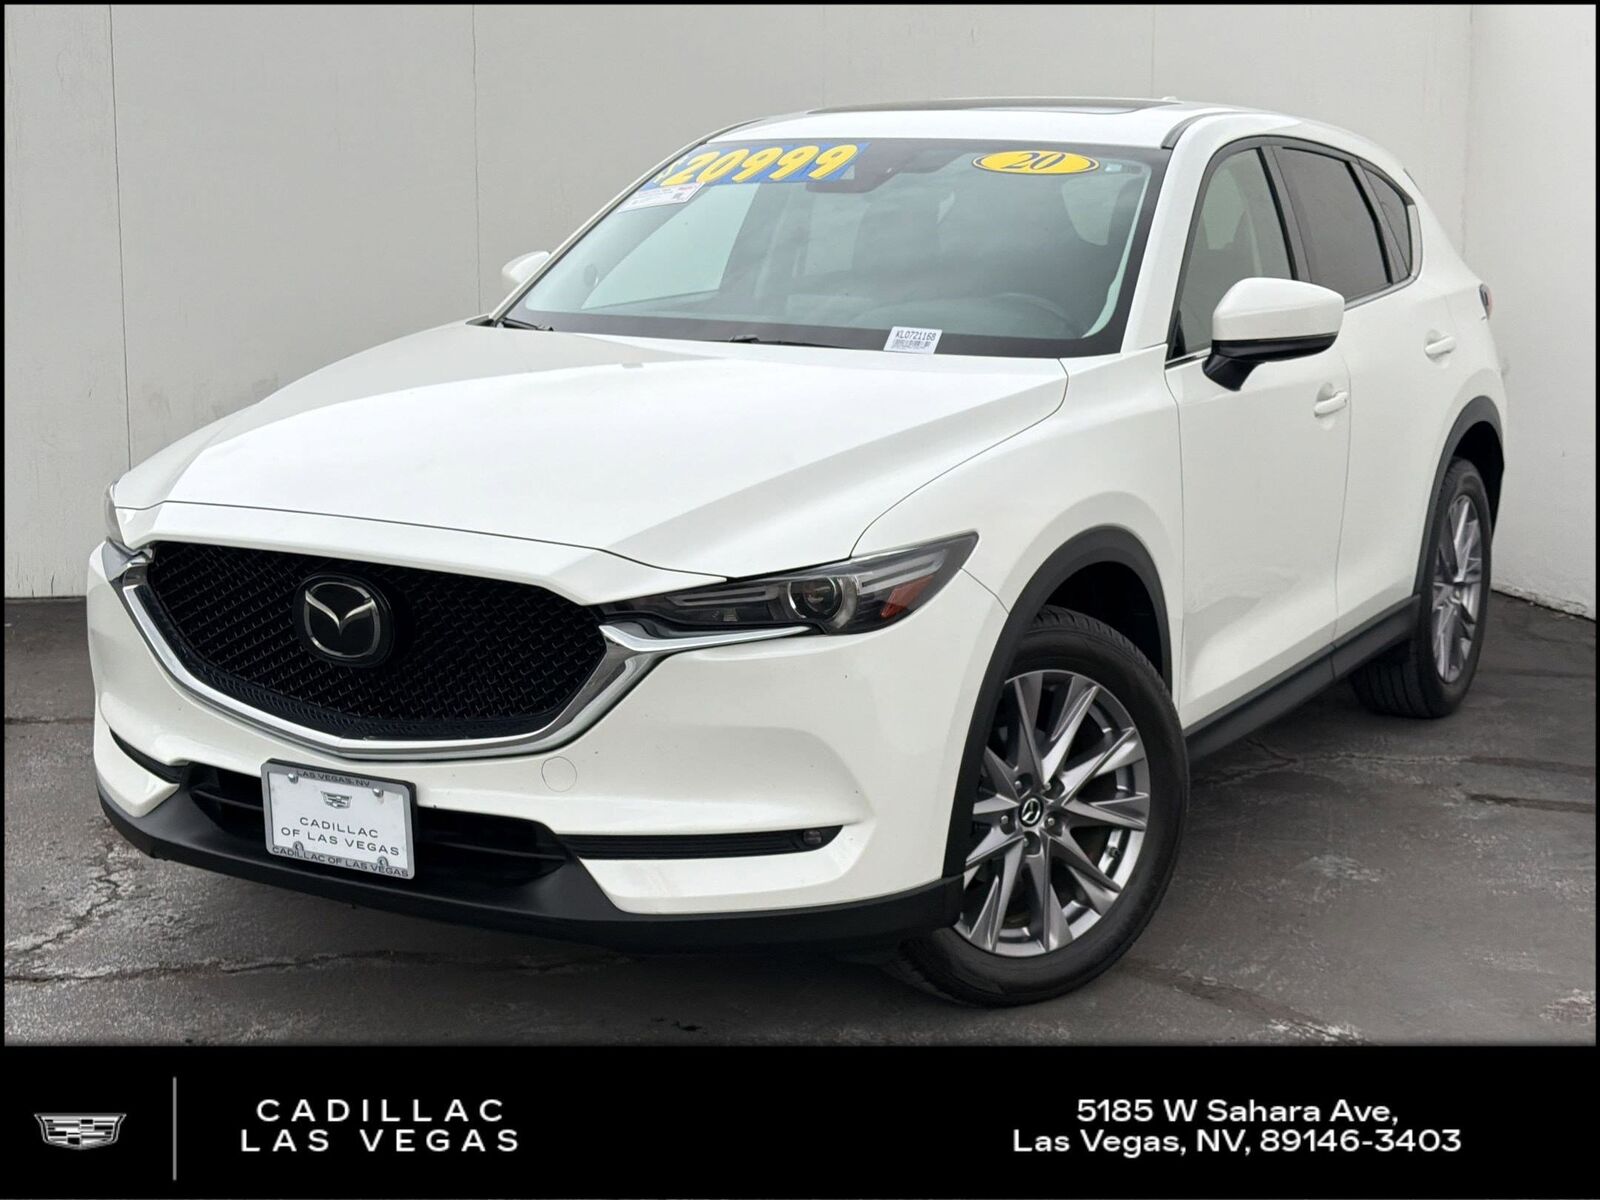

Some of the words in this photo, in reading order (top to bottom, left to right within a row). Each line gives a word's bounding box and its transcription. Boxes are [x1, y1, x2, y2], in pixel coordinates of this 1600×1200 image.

[1001, 152, 1066, 170] 20
[296, 770, 316, 779] LAS
[355, 779, 370, 787] NV
[300, 817, 378, 838] CADILLAC
[281, 827, 301, 837] OF
[307, 832, 338, 845] LAS
[344, 838, 399, 856] VEGAS
[272, 846, 326, 864] CADILLAC
[328, 857, 343, 865] OF
[345, 859, 368, 870] LAS
[371, 864, 409, 877] VEGAS
